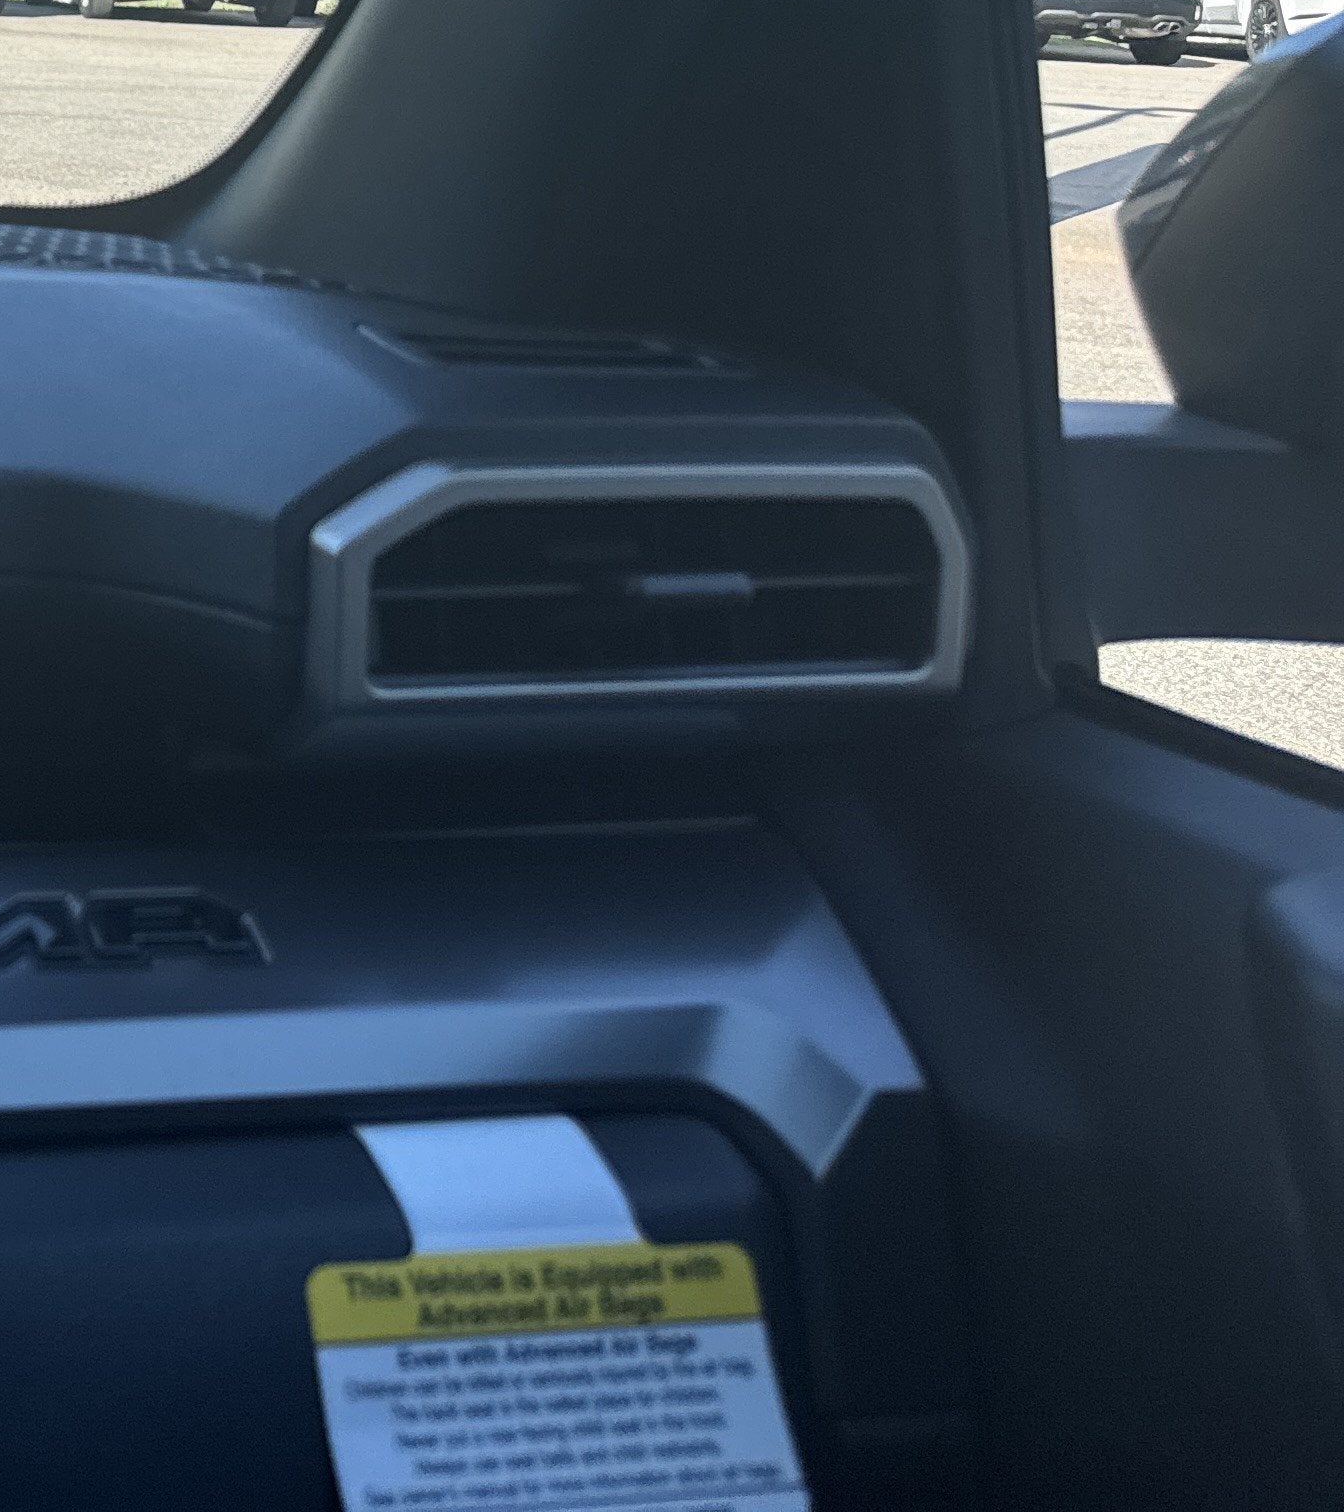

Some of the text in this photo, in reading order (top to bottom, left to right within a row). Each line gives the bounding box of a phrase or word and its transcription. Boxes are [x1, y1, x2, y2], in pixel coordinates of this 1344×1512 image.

[344, 1256, 723, 1301] This Vehicle is Equipped with
[417, 1291, 664, 1328] Advanced Air Bags
